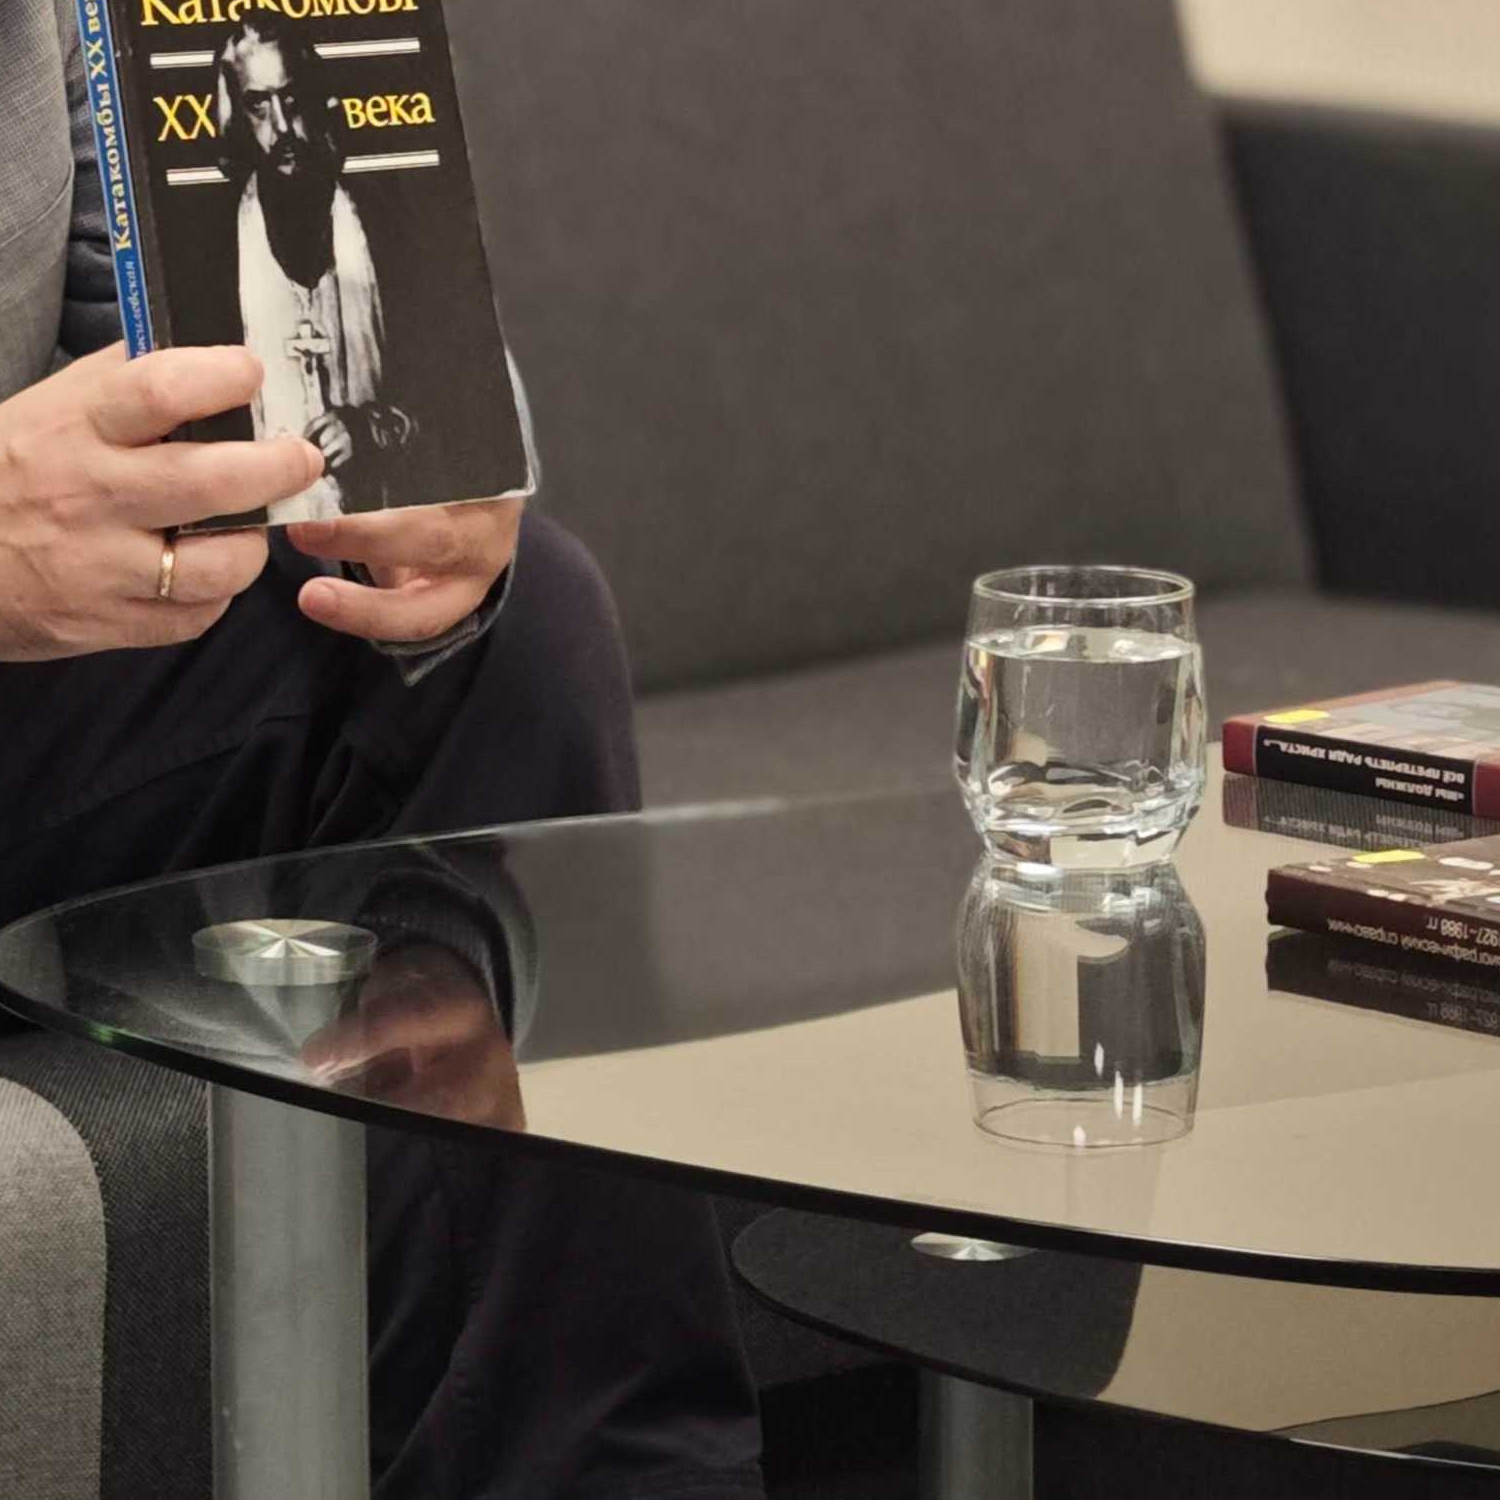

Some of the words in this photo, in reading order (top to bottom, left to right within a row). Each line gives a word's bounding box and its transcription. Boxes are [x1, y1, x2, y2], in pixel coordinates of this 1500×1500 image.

[341, 91, 436, 129] века
[96, 83, 132, 251] Катакомбы
[1328, 749, 1362, 766] РАДИ
[1375, 777, 1434, 797] ДОЛЖНЫ
